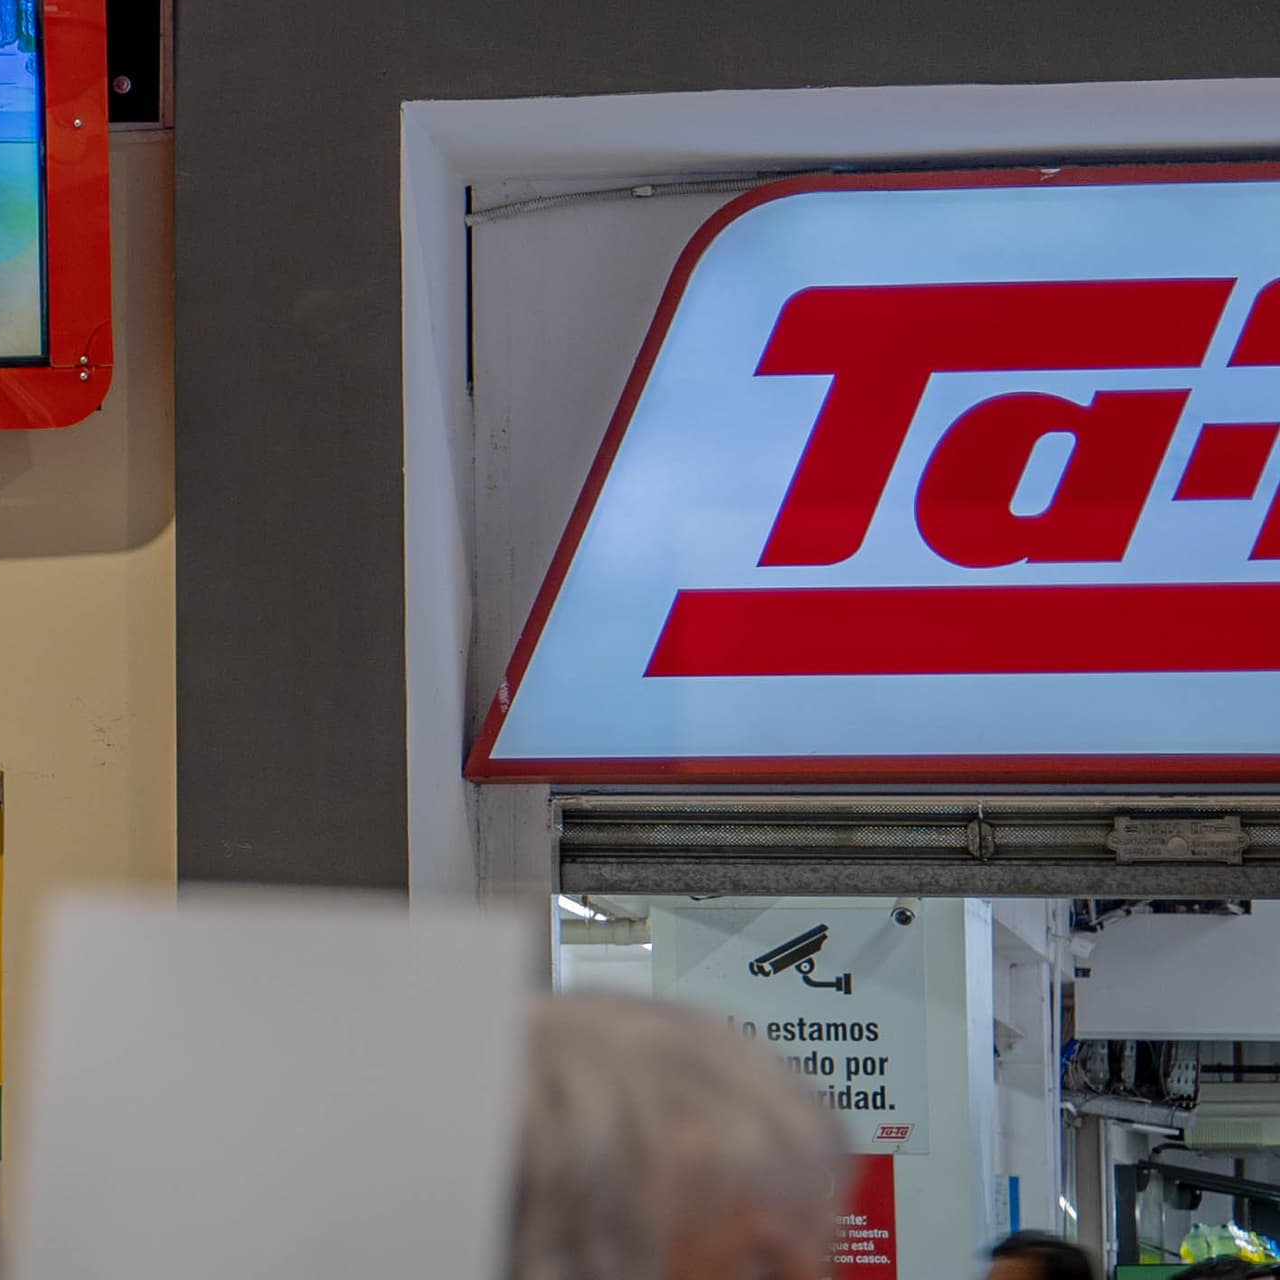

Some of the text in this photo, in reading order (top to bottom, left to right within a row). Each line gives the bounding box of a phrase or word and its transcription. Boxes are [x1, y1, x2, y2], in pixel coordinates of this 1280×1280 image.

[753, 276, 1280, 569] Ta-
[766, 1017, 880, 1042] estamos
[846, 1055, 888, 1081] por
[880, 1126, 910, 1137] Ta-Ta
[849, 1228, 889, 1238] nuestra
[851, 1240, 875, 1250] está
[834, 1254, 891, 1264] con casco.
